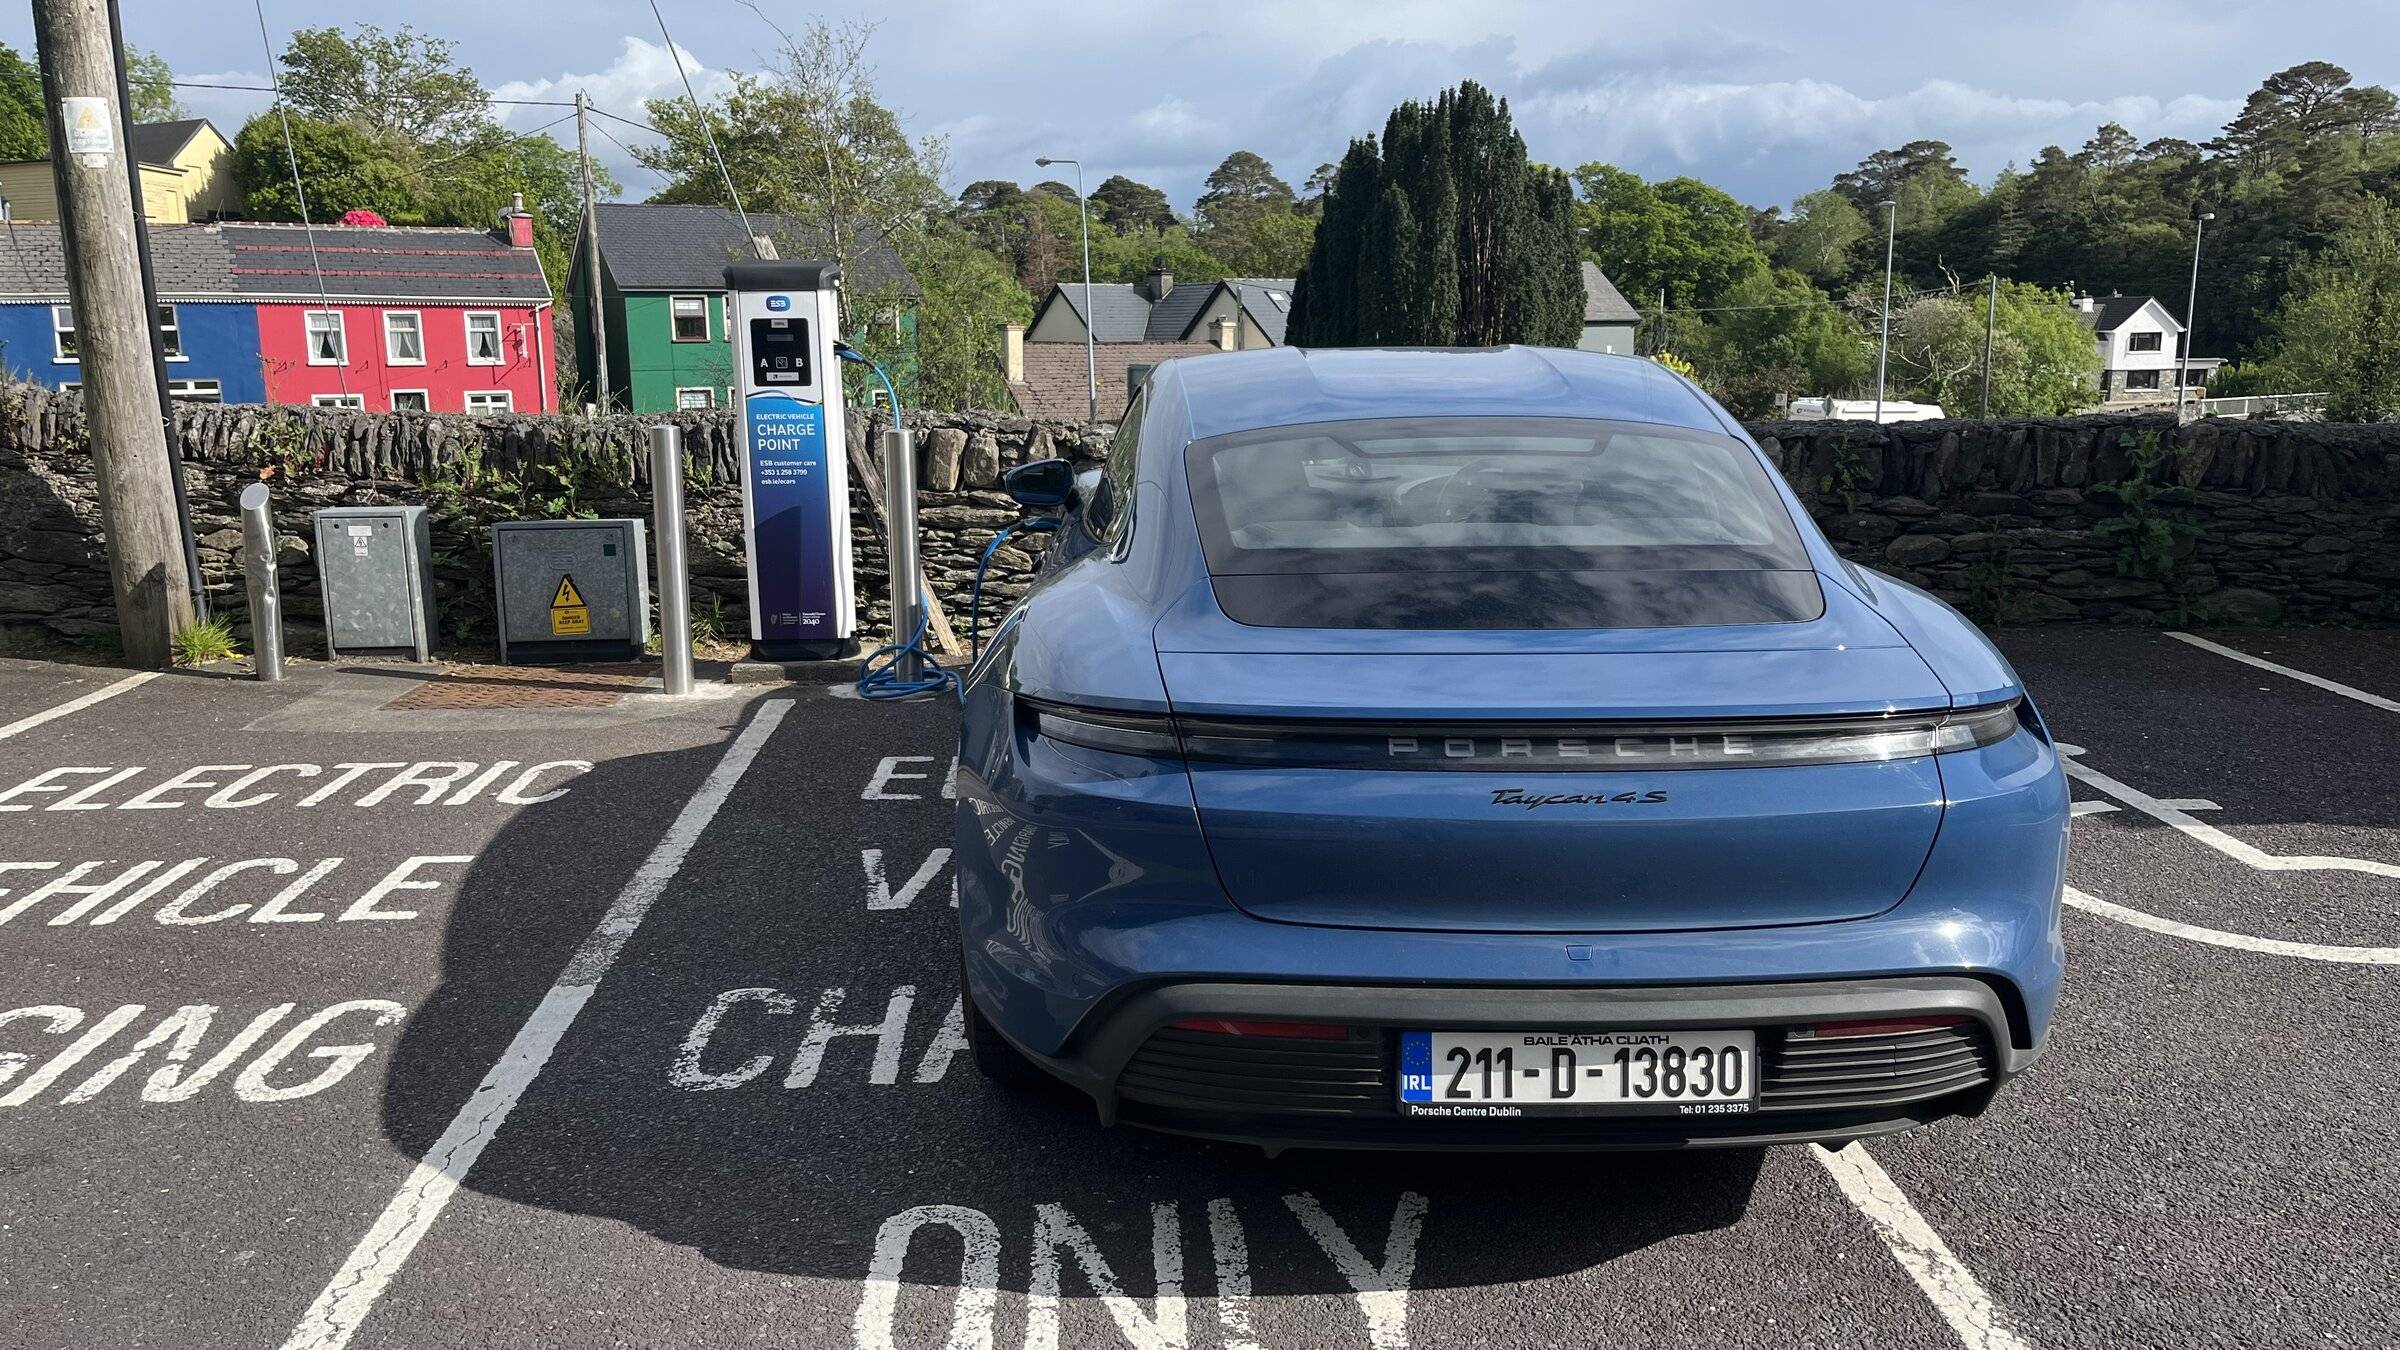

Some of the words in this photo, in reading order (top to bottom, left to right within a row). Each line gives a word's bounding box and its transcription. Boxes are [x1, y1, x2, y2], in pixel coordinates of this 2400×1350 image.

[770, 300, 786, 308] ESB
[760, 358, 768, 367] A
[795, 358, 803, 367] B
[757, 423, 816, 436] CHARGE
[758, 438, 801, 451] POINT
[1388, 736, 1754, 758] PORSCHE
[0, 760, 595, 811] ELECTRIC
[1490, 788, 1607, 810] Taycan
[1610, 790, 1668, 804] 4S
[1523, 1036, 1567, 1046] BAILE
[1616, 1034, 1669, 1045] CLIATH
[1445, 1045, 1743, 1099] 211-D-13830
[1404, 1074, 1432, 1091] IRL
[1411, 1105, 1452, 1117] Porsche
[1454, 1106, 1487, 1117] Centre
[1489, 1105, 1522, 1117] Dublin
[1680, 1104, 1694, 1115] Tel:
[1695, 1105, 1706, 1114] 01
[1708, 1104, 1725, 1114] 235
[1727, 1103, 1749, 1114] 3375
[853, 1191, 1428, 1350] ONLY
